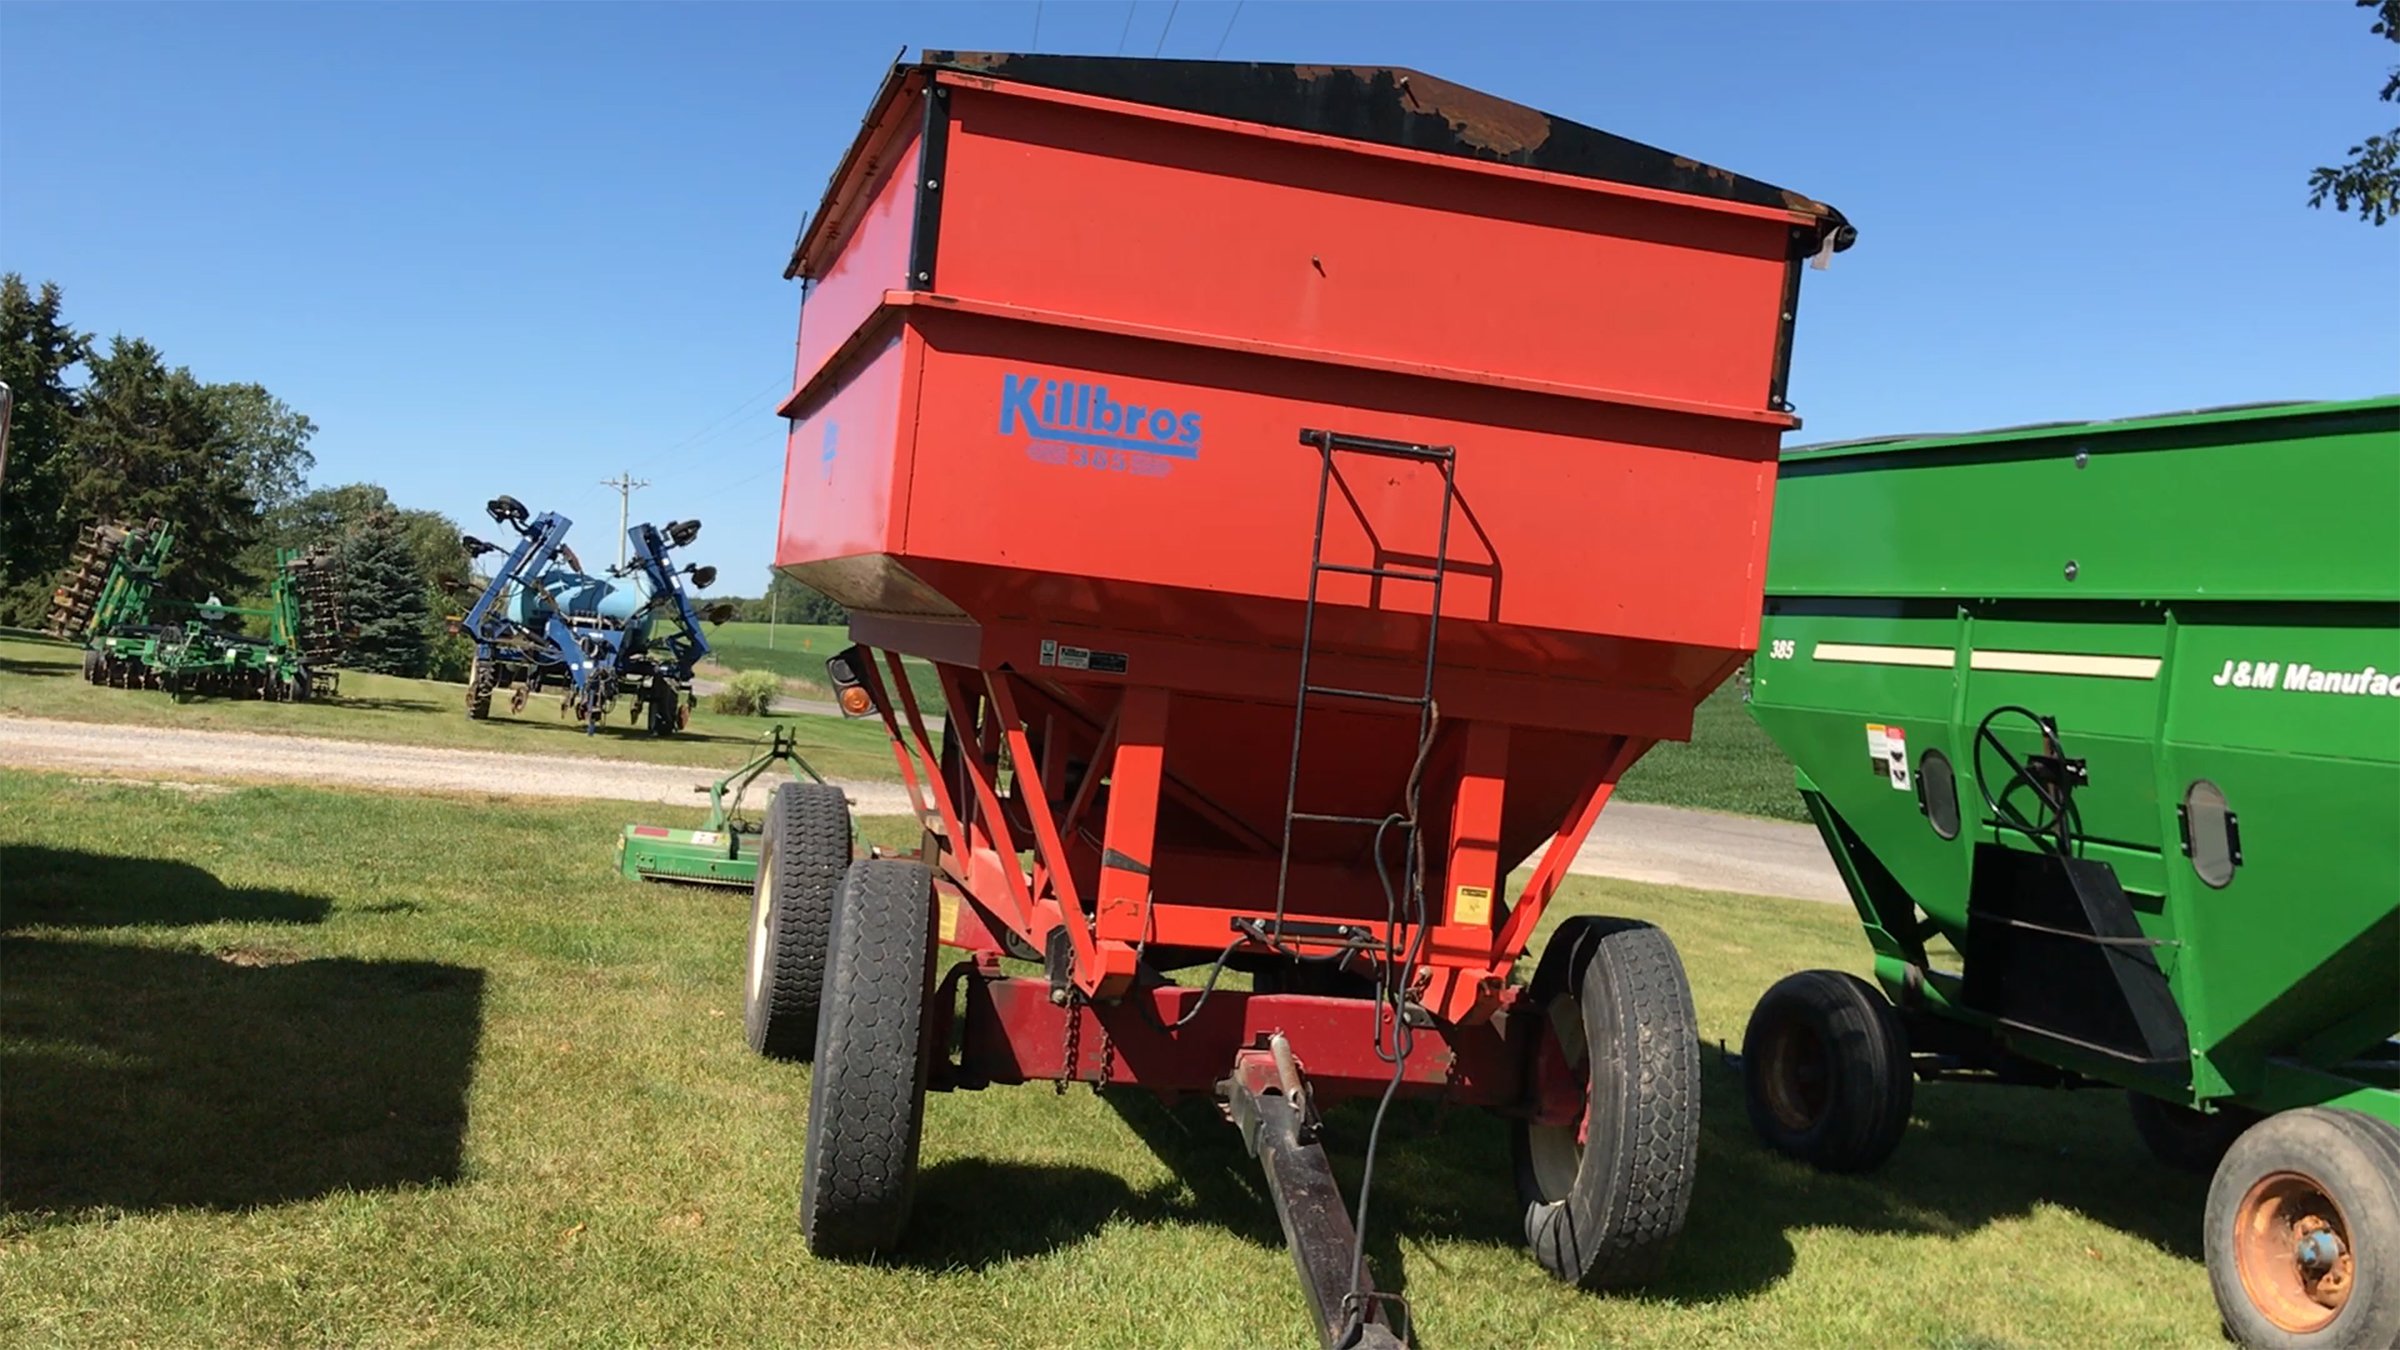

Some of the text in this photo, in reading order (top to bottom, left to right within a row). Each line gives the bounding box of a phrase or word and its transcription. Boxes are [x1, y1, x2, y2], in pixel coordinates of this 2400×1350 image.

[999, 373, 1202, 446] Killbros
[1770, 639, 1795, 660] 385
[2212, 659, 2280, 689] J&M
